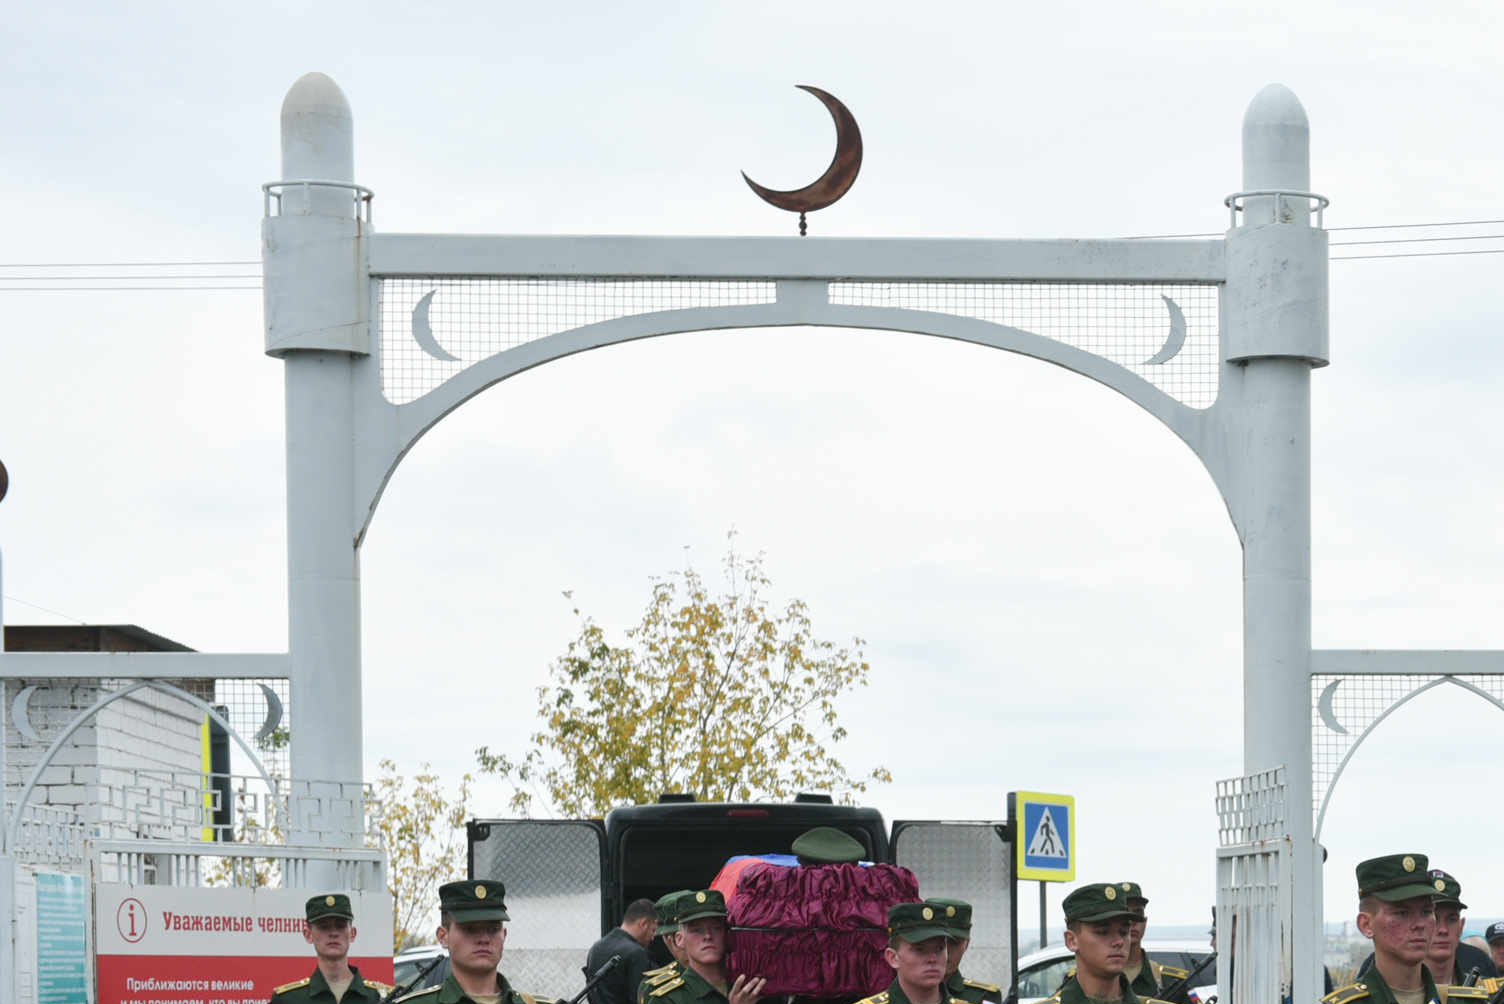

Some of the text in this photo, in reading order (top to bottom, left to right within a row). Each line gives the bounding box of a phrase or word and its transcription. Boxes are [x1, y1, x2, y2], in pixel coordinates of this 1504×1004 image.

[163, 911, 253, 932] Уважаемые
[126, 977, 254, 992] Приближаются великие
